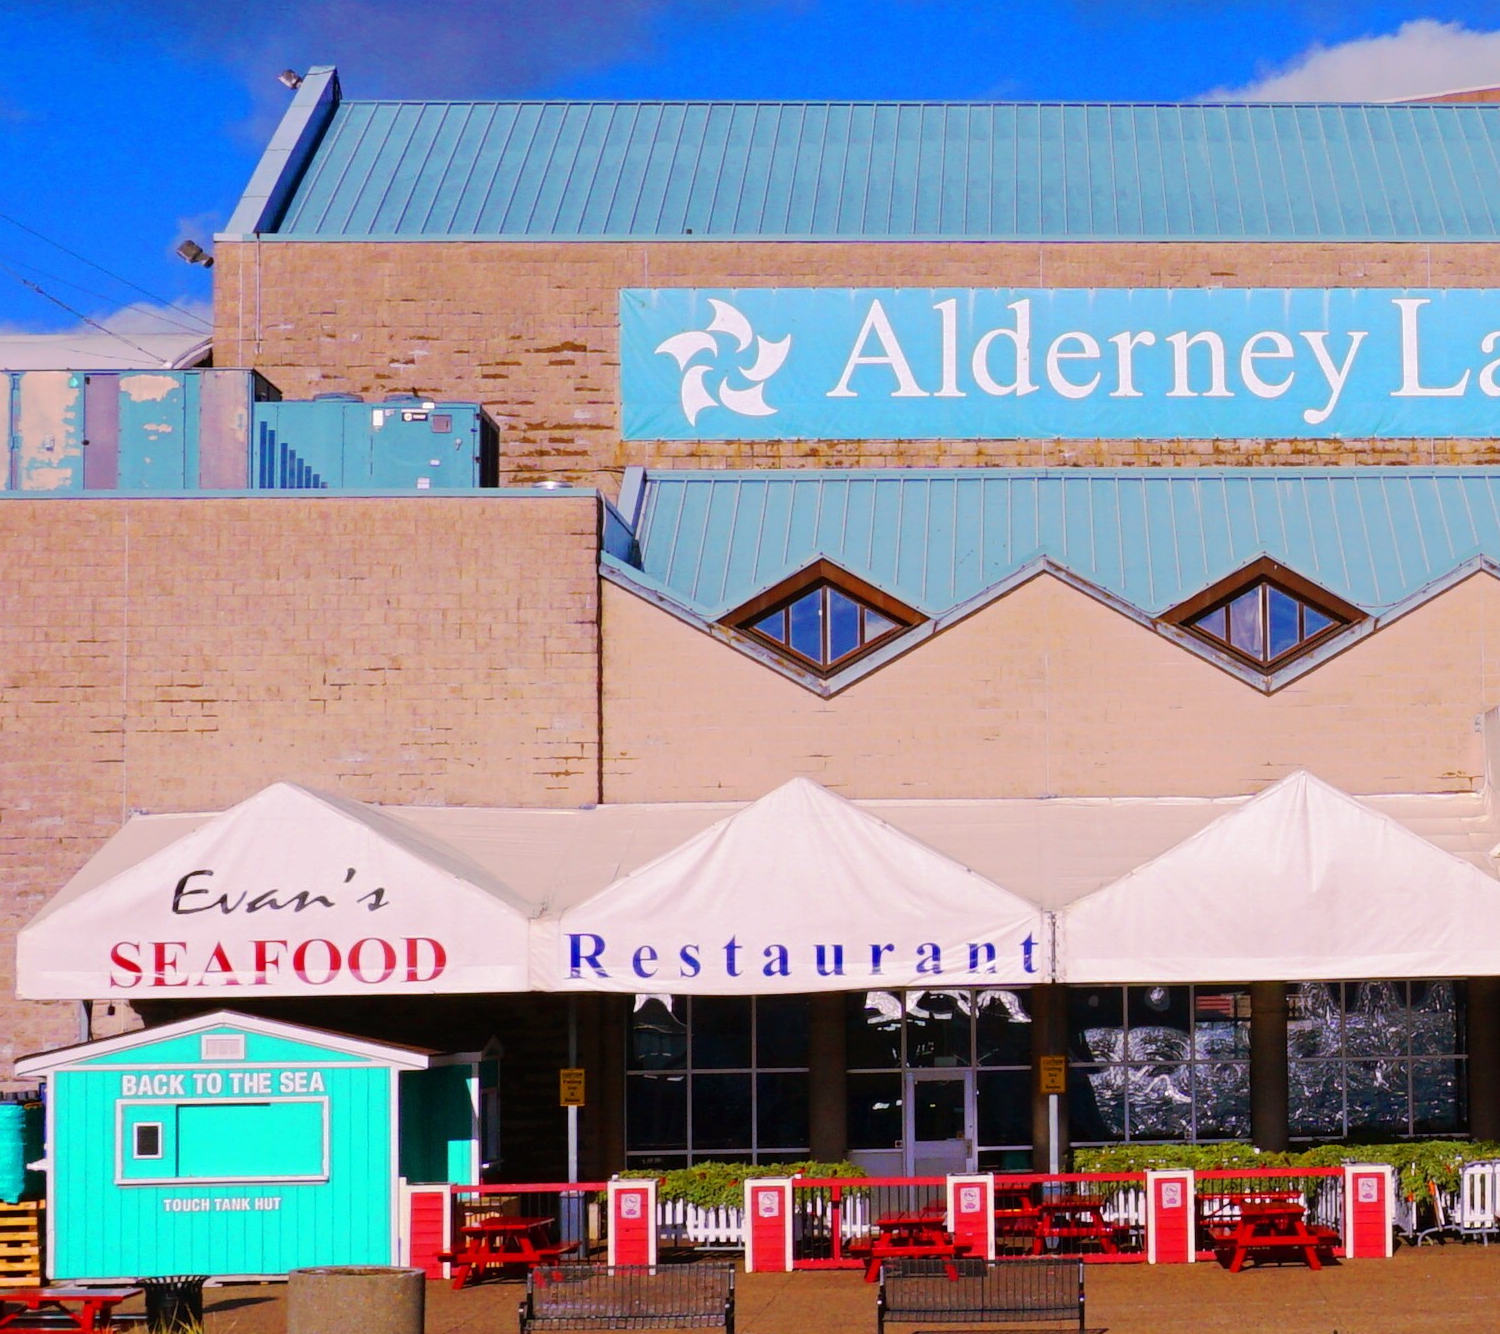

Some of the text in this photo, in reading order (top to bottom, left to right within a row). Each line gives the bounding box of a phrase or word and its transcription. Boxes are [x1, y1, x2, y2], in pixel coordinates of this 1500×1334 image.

[825, 297, 1369, 425] Alderney
[171, 867, 390, 915] Evan's
[109, 937, 448, 989] SEAFOOD
[563, 931, 1041, 980] Restaurant
[121, 1071, 325, 1096] BACK TO THE SEA
[163, 1197, 281, 1212] TOUCH TANK HUT
